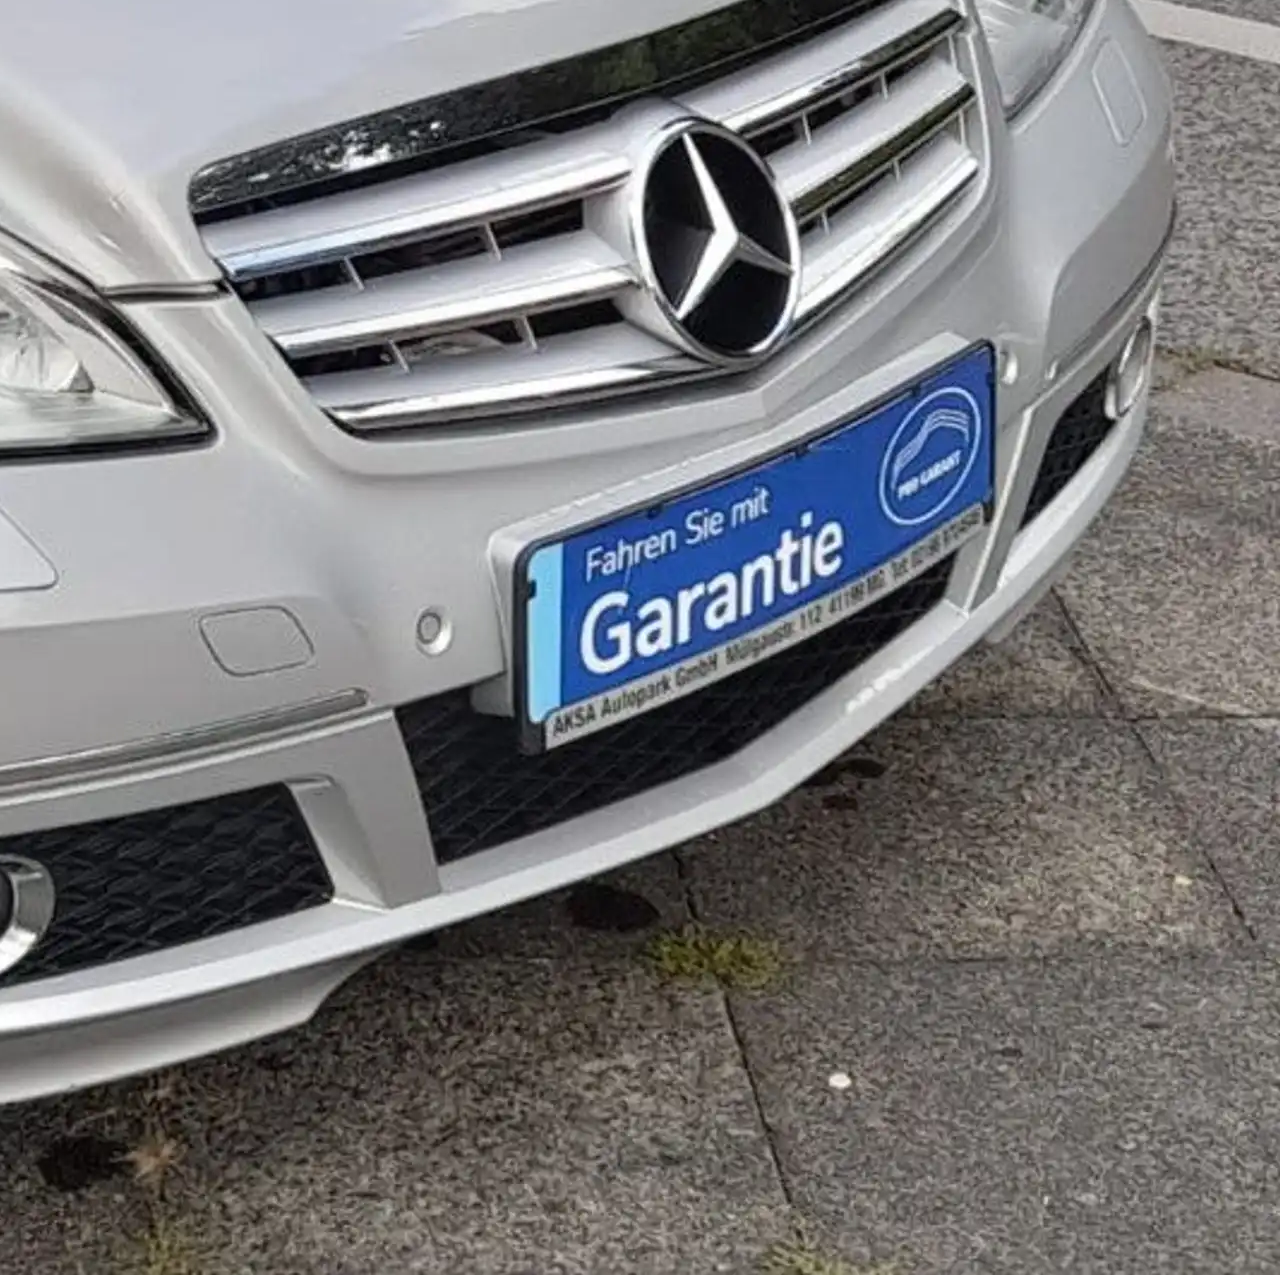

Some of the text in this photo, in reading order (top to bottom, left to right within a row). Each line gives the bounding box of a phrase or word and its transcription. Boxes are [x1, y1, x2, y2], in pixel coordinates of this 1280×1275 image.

[585, 486, 771, 583] Fahren Sie mit
[579, 510, 845, 675] Garantie
[552, 703, 597, 737] AKSA
[600, 675, 672, 719] Autopark
[674, 652, 719, 688] GmbH
